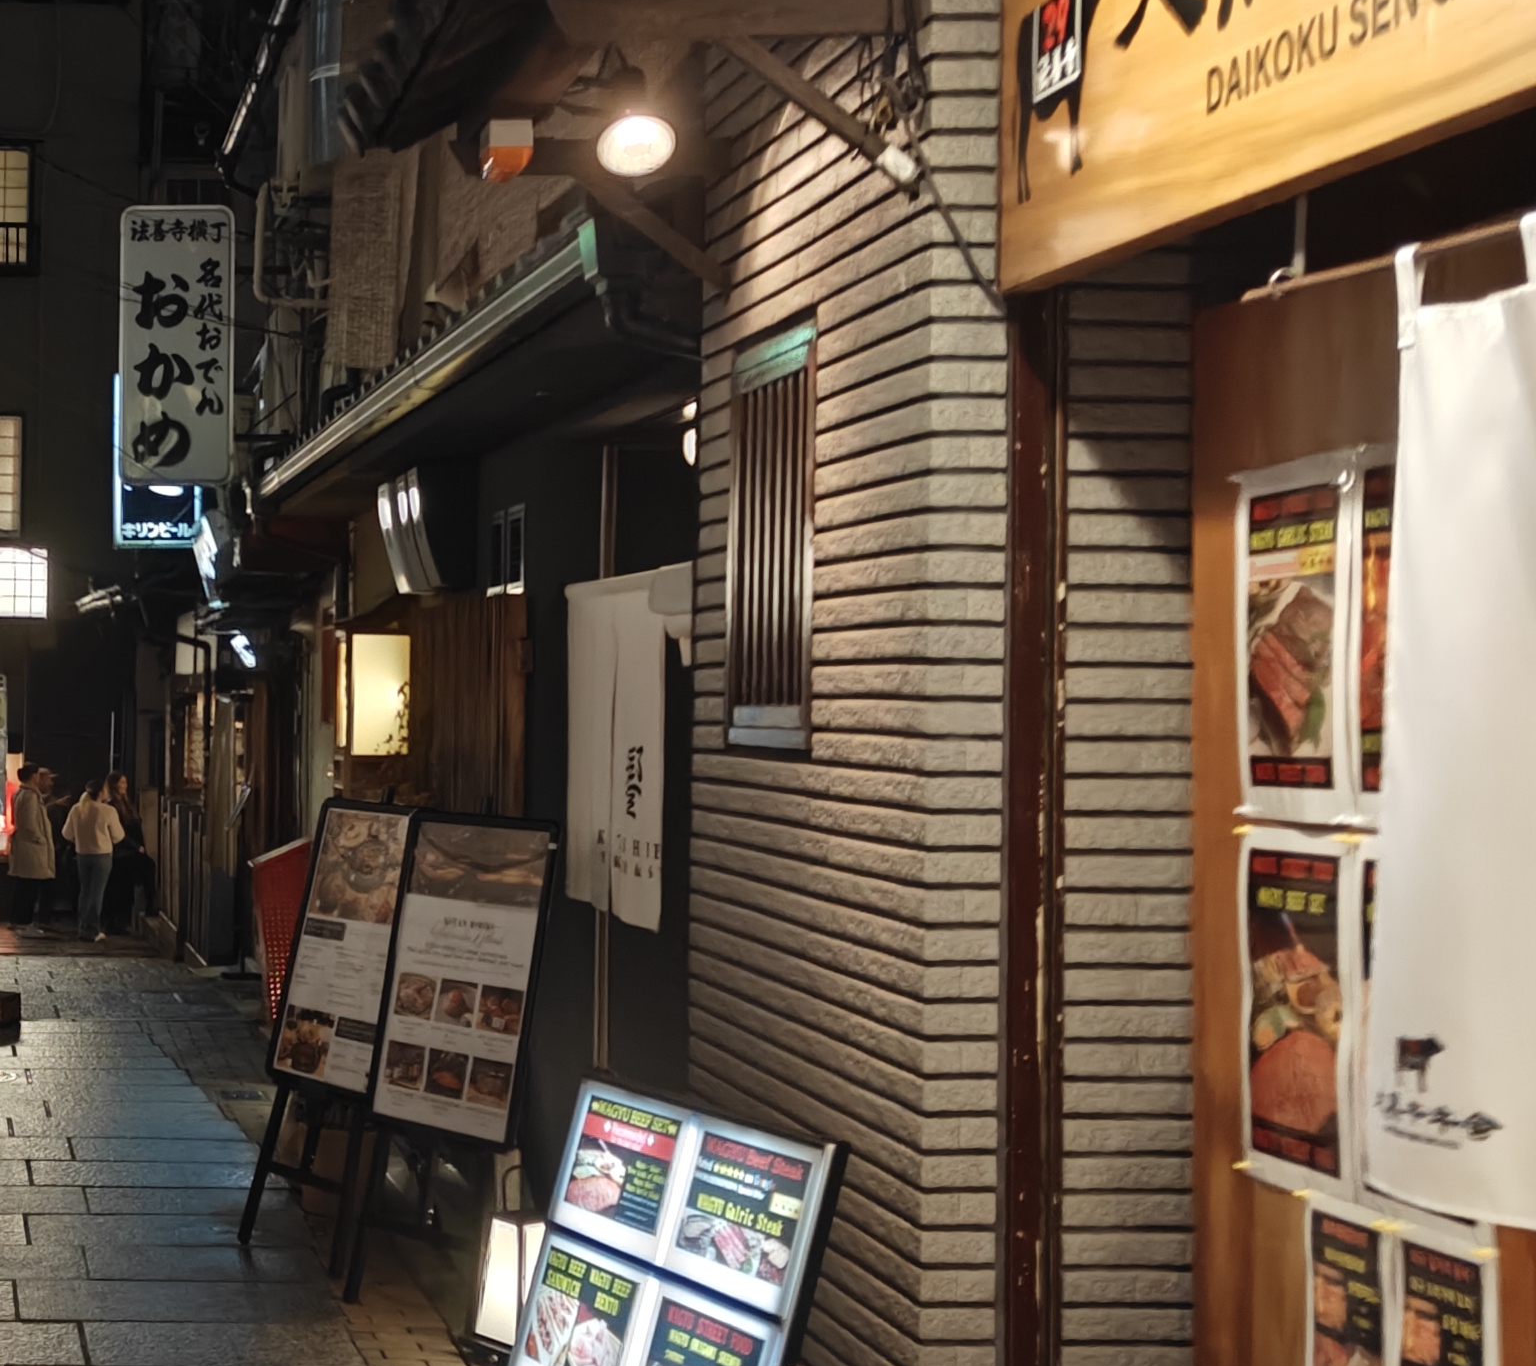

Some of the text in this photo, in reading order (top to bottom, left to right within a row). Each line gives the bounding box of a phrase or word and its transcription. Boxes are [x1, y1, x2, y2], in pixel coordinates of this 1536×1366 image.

[1206, 3, 1339, 116] DAIKOKU
[130, 218, 227, 244] 法善寺横丁
[132, 271, 195, 467] おかめ
[193, 257, 224, 416] 名代おでん
[122, 521, 192, 539] キリンビール
[755, 1212, 784, 1237] Steak
